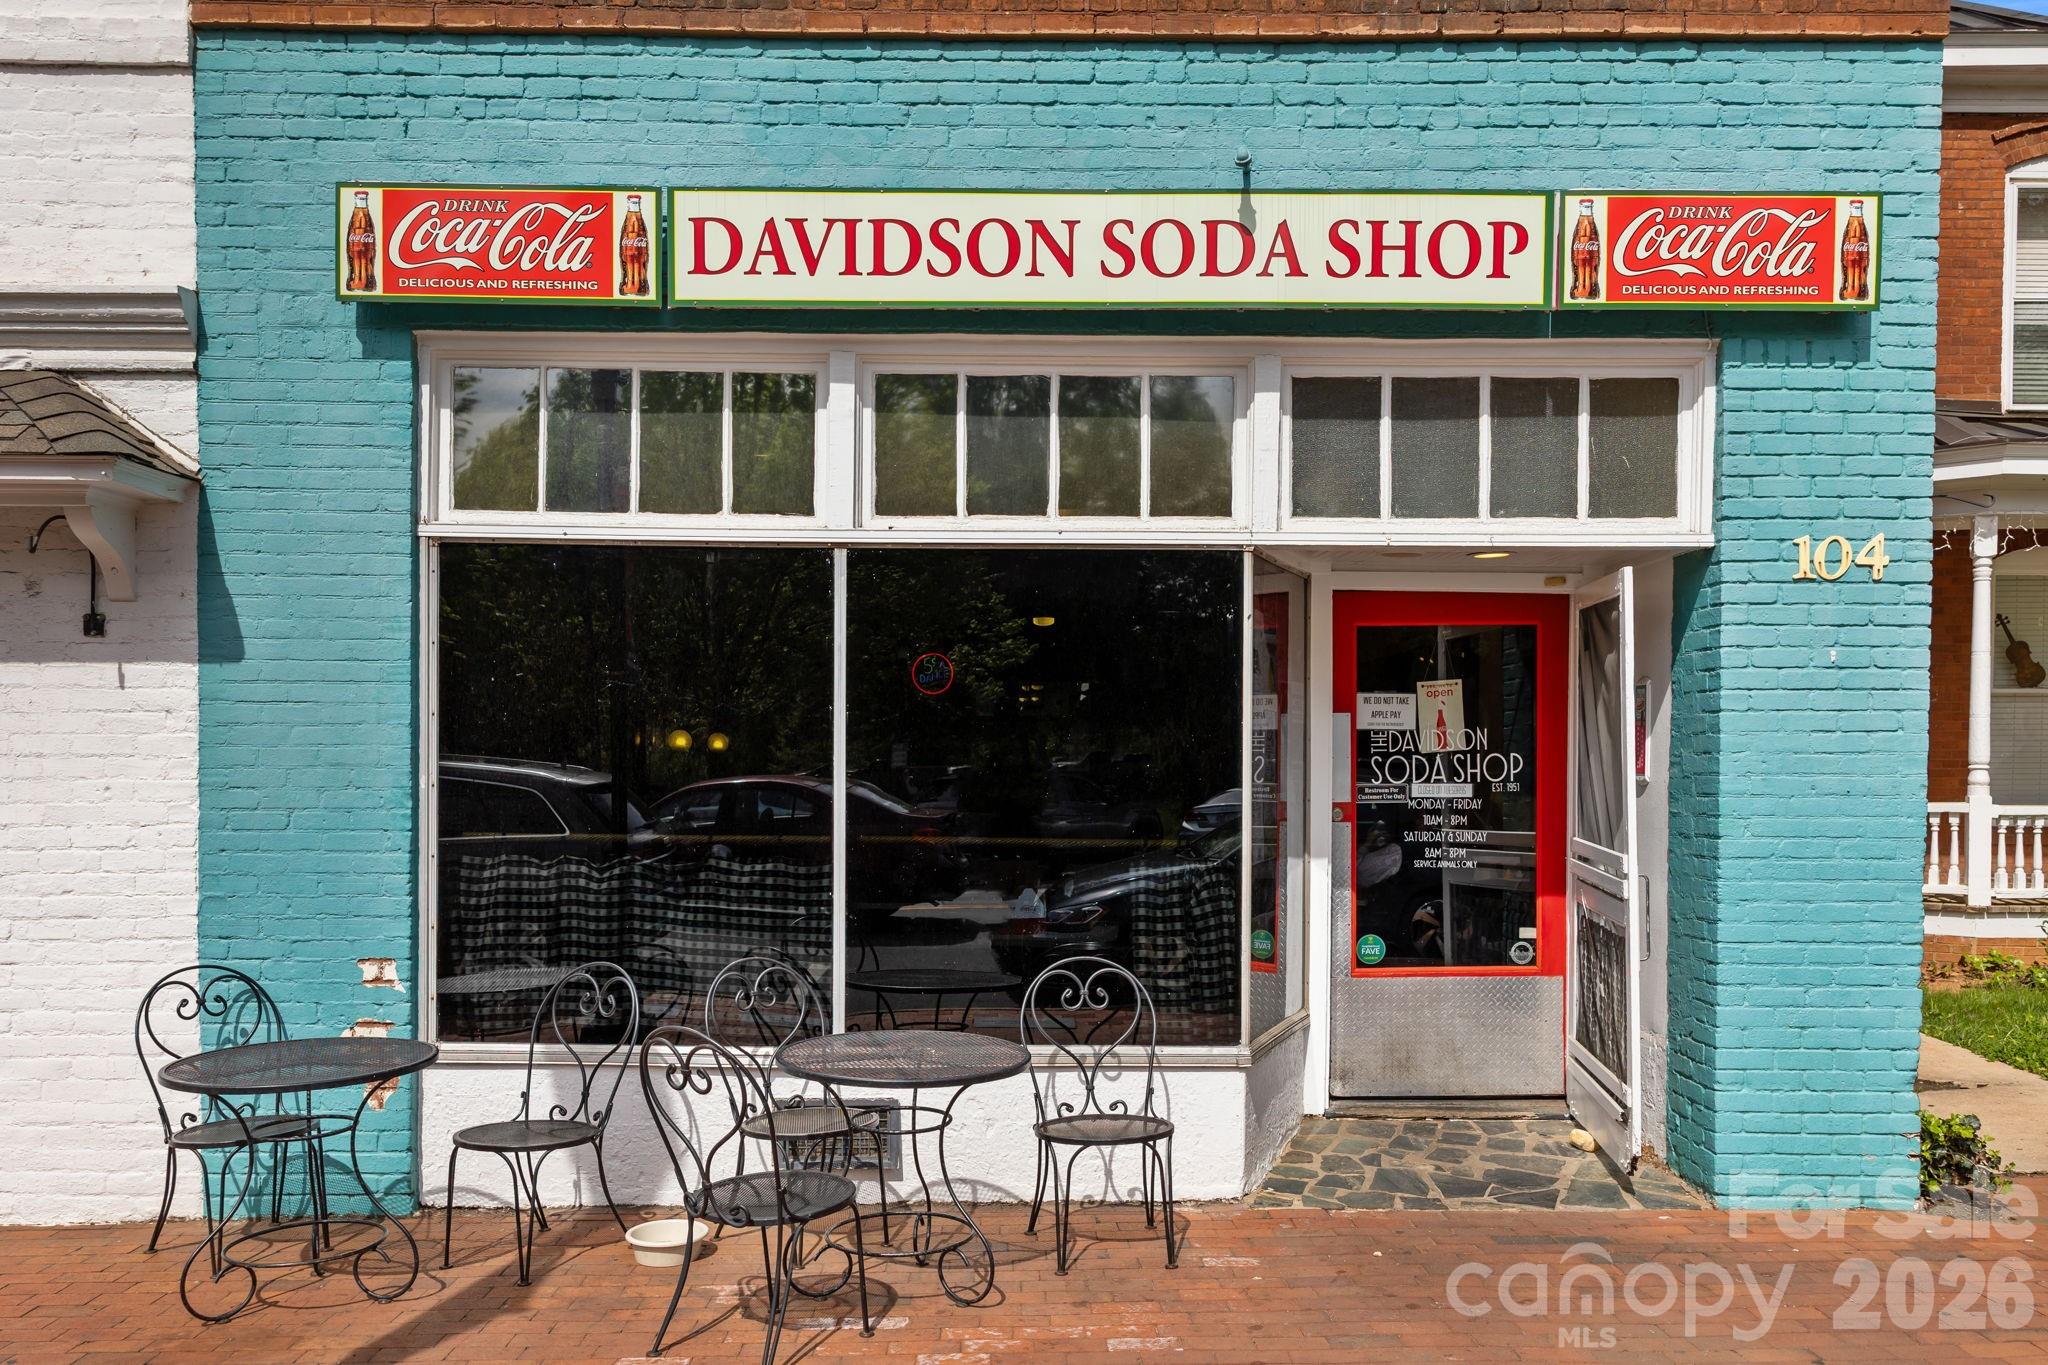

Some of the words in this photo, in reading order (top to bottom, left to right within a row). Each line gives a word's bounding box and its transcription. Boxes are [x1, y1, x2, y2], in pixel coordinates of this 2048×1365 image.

[443, 199, 510, 213] DRINK
[1667, 206, 1734, 219] DRINK
[687, 216, 1081, 278] DAVIDSON
[1100, 218, 1309, 279] SODA
[1325, 219, 1530, 280] SHOP
[399, 277, 474, 289] DELICIOUS
[476, 278, 508, 289] AND
[512, 279, 599, 291] REFRESHING
[1622, 285, 1696, 295] DELICIOUS
[1699, 285, 1730, 295] AND
[1733, 285, 1820, 296] REFRESHING
[1791, 532, 1890, 582] 104
[1426, 689, 1454, 699] open
[1363, 696, 1372, 704] WE
[1374, 696, 1381, 704] DO
[1383, 696, 1394, 704] NOT
[1395, 696, 1409, 704] TAKE
[1371, 711, 1388, 719] APPLE
[1390, 711, 1401, 719] PAY
[1371, 729, 1387, 753] THE
[1389, 726, 1488, 752] DAVIDSON
[1371, 753, 1447, 784] SODA
[1453, 753, 1523, 783] SHOP
[1492, 783, 1505, 792] EST.
[1507, 783, 1520, 792] 1951
[1408, 799, 1445, 809] MONDAY
[1453, 799, 1482, 809] FRIDAY
[1423, 815, 1442, 825] 10AM
[1450, 815, 1468, 825] 8PM
[1404, 831, 1446, 842] SATURDAY
[1447, 831, 1454, 841] &
[1455, 831, 1488, 842] SUNDAY
[1425, 847, 1441, 858] 8AM
[1449, 847, 1466, 858] 8PM
[1414, 860, 1436, 868] SERVICE
[1437, 860, 1461, 868] ANIMALS
[1461, 860, 1478, 868] ONLY
[1361, 947, 1380, 955] FAVE
